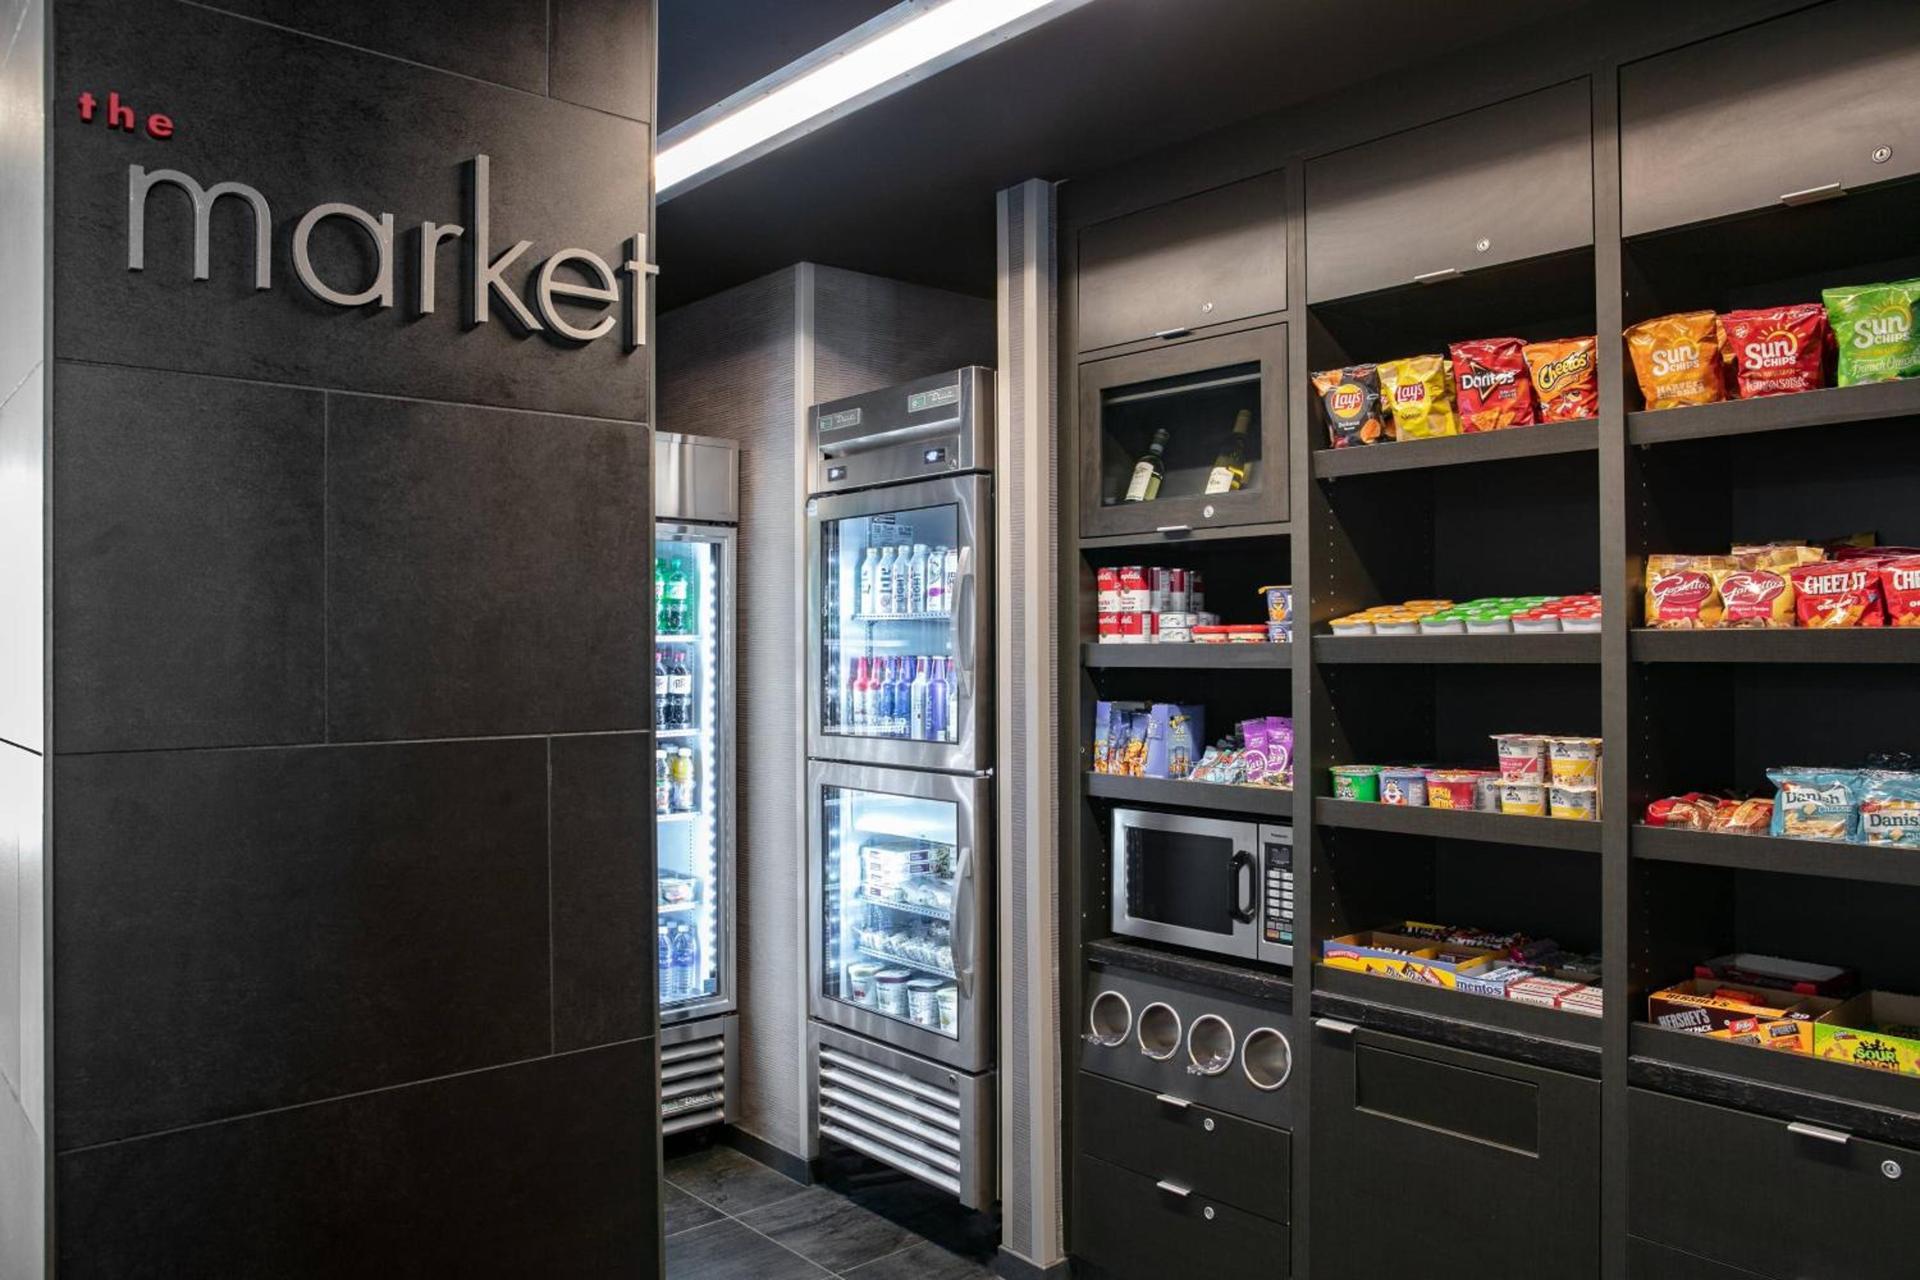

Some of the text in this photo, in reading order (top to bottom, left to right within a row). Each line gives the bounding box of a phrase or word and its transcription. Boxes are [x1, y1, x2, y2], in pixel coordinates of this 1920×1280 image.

[78, 91, 174, 139] the
[127, 153, 660, 347] market
[1854, 315, 1909, 349] Sun
[1874, 331, 1910, 345] CHIPS
[1652, 345, 1700, 377] Sun
[1744, 340, 1798, 369] Sun
[1763, 356, 1796, 368] CHIPS
[1538, 352, 1588, 391] Cheetos
[1669, 360, 1700, 372] CHIPS
[1461, 371, 1515, 390] Doritos
[1893, 570, 1920, 591] CHE
[1870, 813, 1920, 827] Danis
[1457, 981, 1502, 996] mentos
[1657, 1008, 1710, 1029] HERSHEY'S
[1855, 1047, 1896, 1063] SOUR
